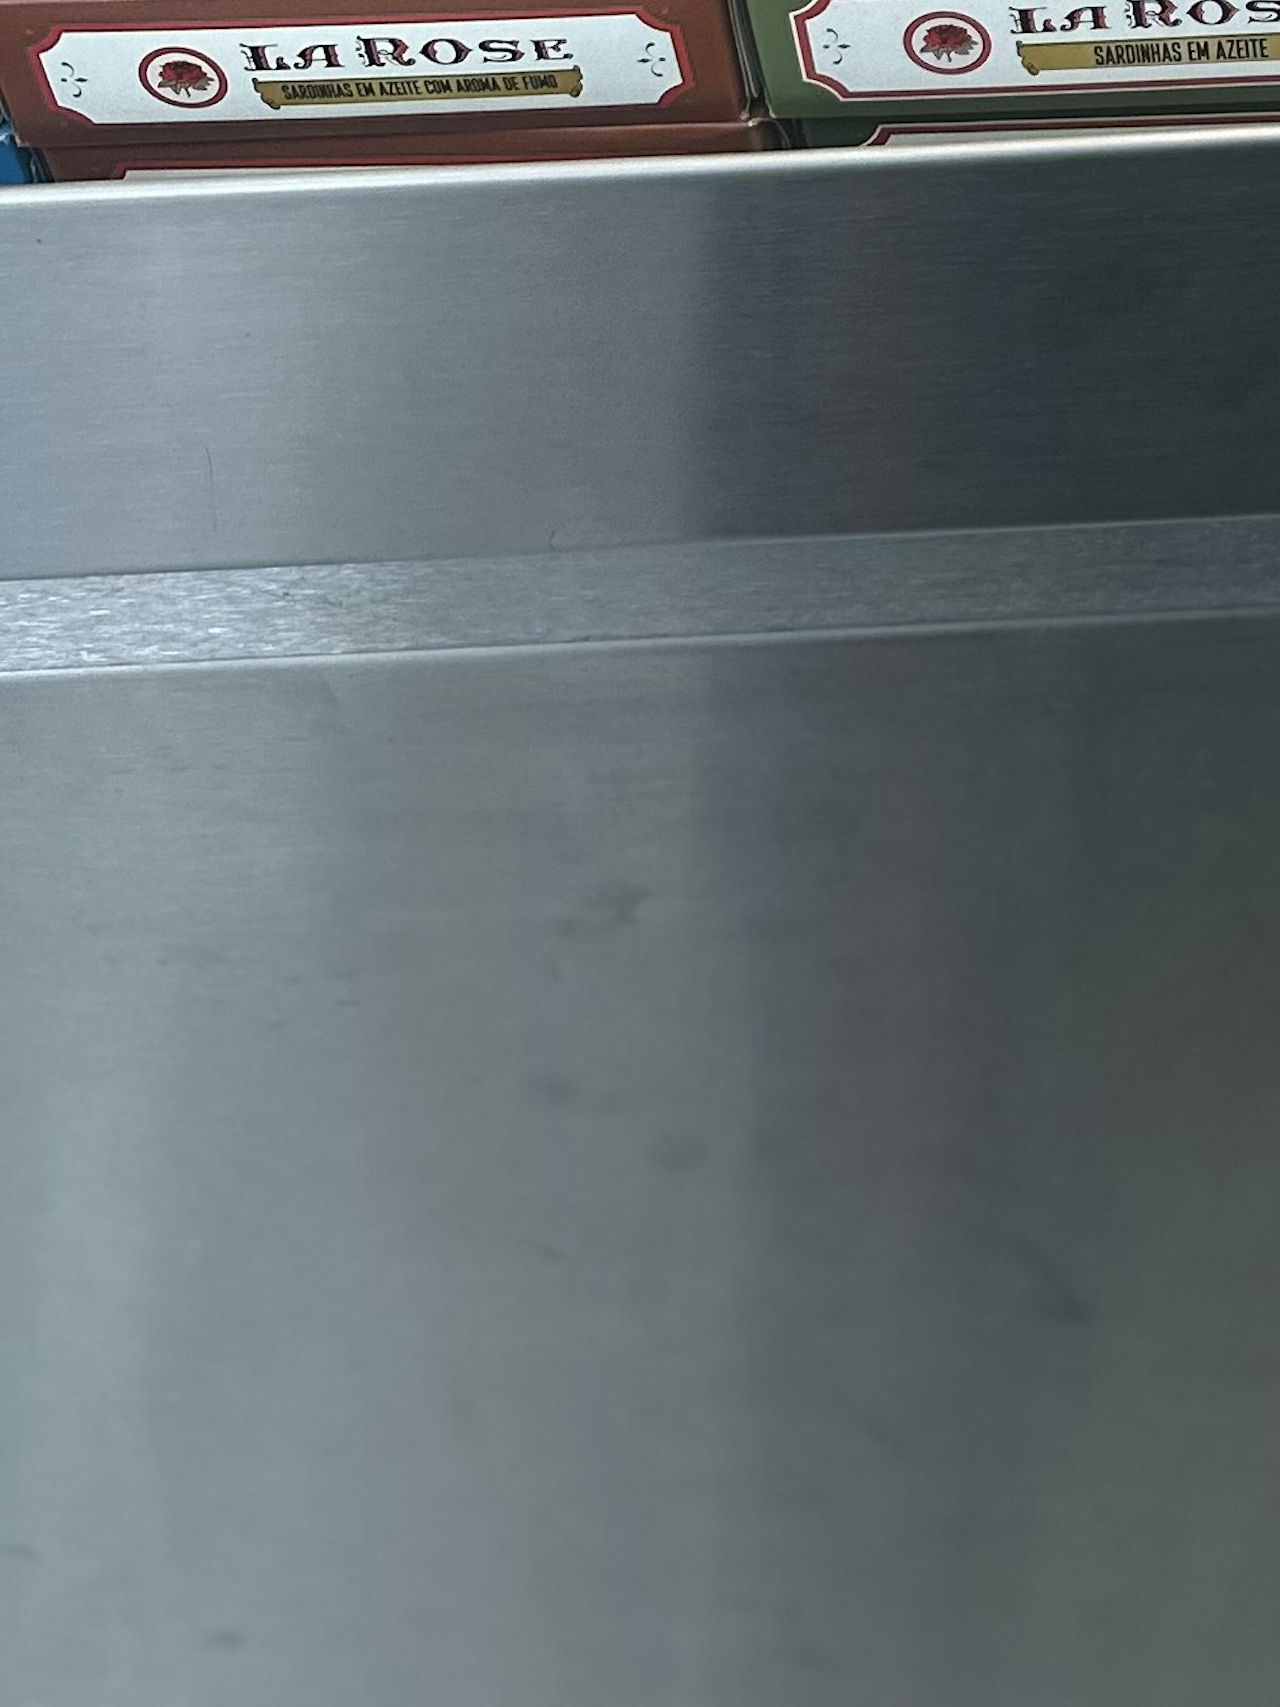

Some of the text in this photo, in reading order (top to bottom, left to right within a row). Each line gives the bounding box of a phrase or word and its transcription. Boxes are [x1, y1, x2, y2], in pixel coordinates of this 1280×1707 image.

[1010, 5, 1111, 35] LA
[240, 34, 573, 72] LA ROSE
[1094, 38, 1269, 64] SARDINHAS EM AZEITE
